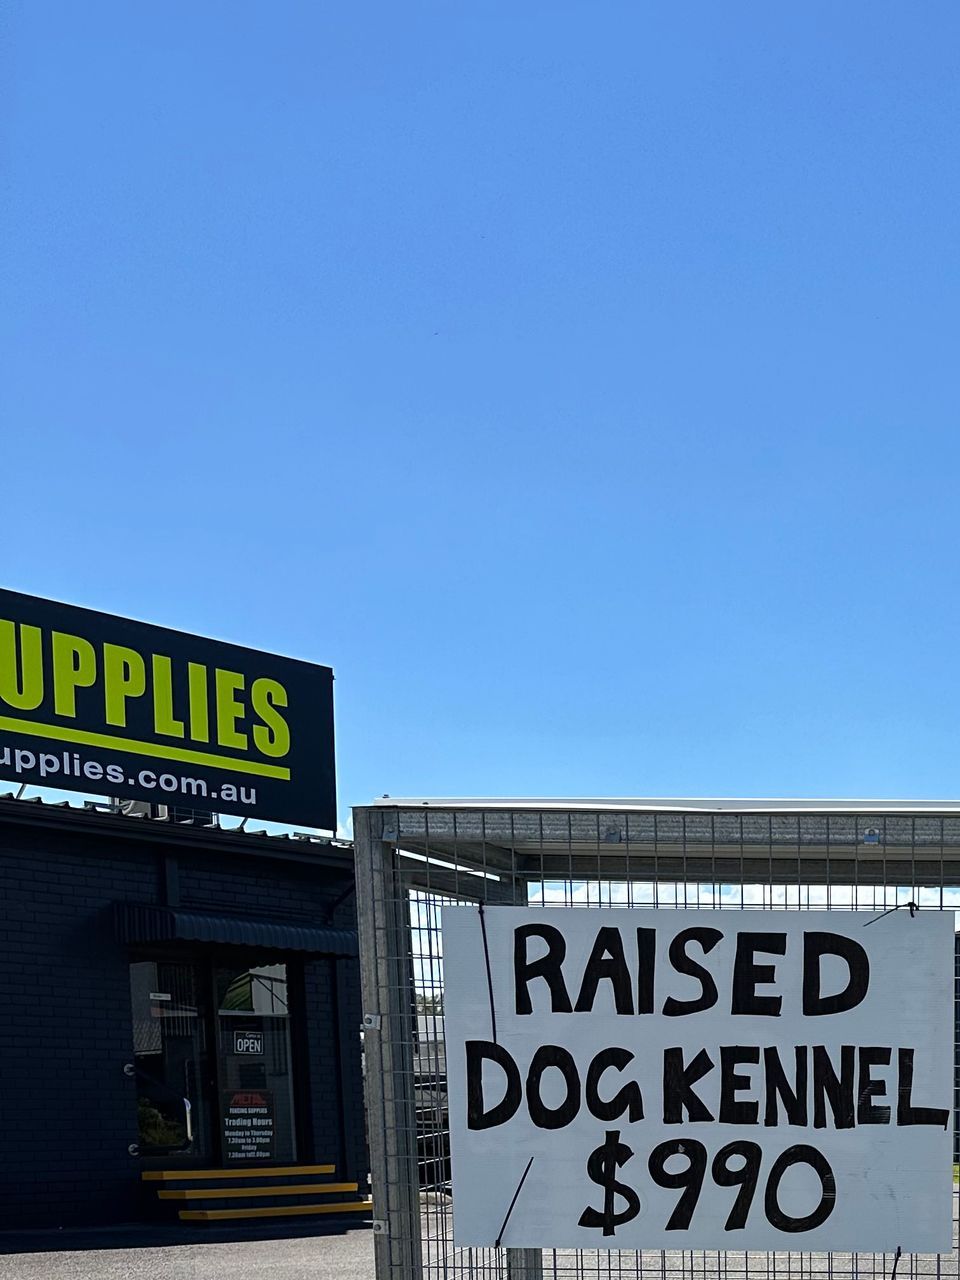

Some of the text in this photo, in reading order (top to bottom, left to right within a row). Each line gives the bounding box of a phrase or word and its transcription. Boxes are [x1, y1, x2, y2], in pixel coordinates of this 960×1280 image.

[0, 619, 290, 758] UPPLIES
[514, 923, 870, 1017] RAISED
[237, 1038, 261, 1052] OPEN
[465, 1040, 950, 1131] DOG KENNEL
[225, 1118, 272, 1127] Trading Hours
[578, 1130, 836, 1236] $990
